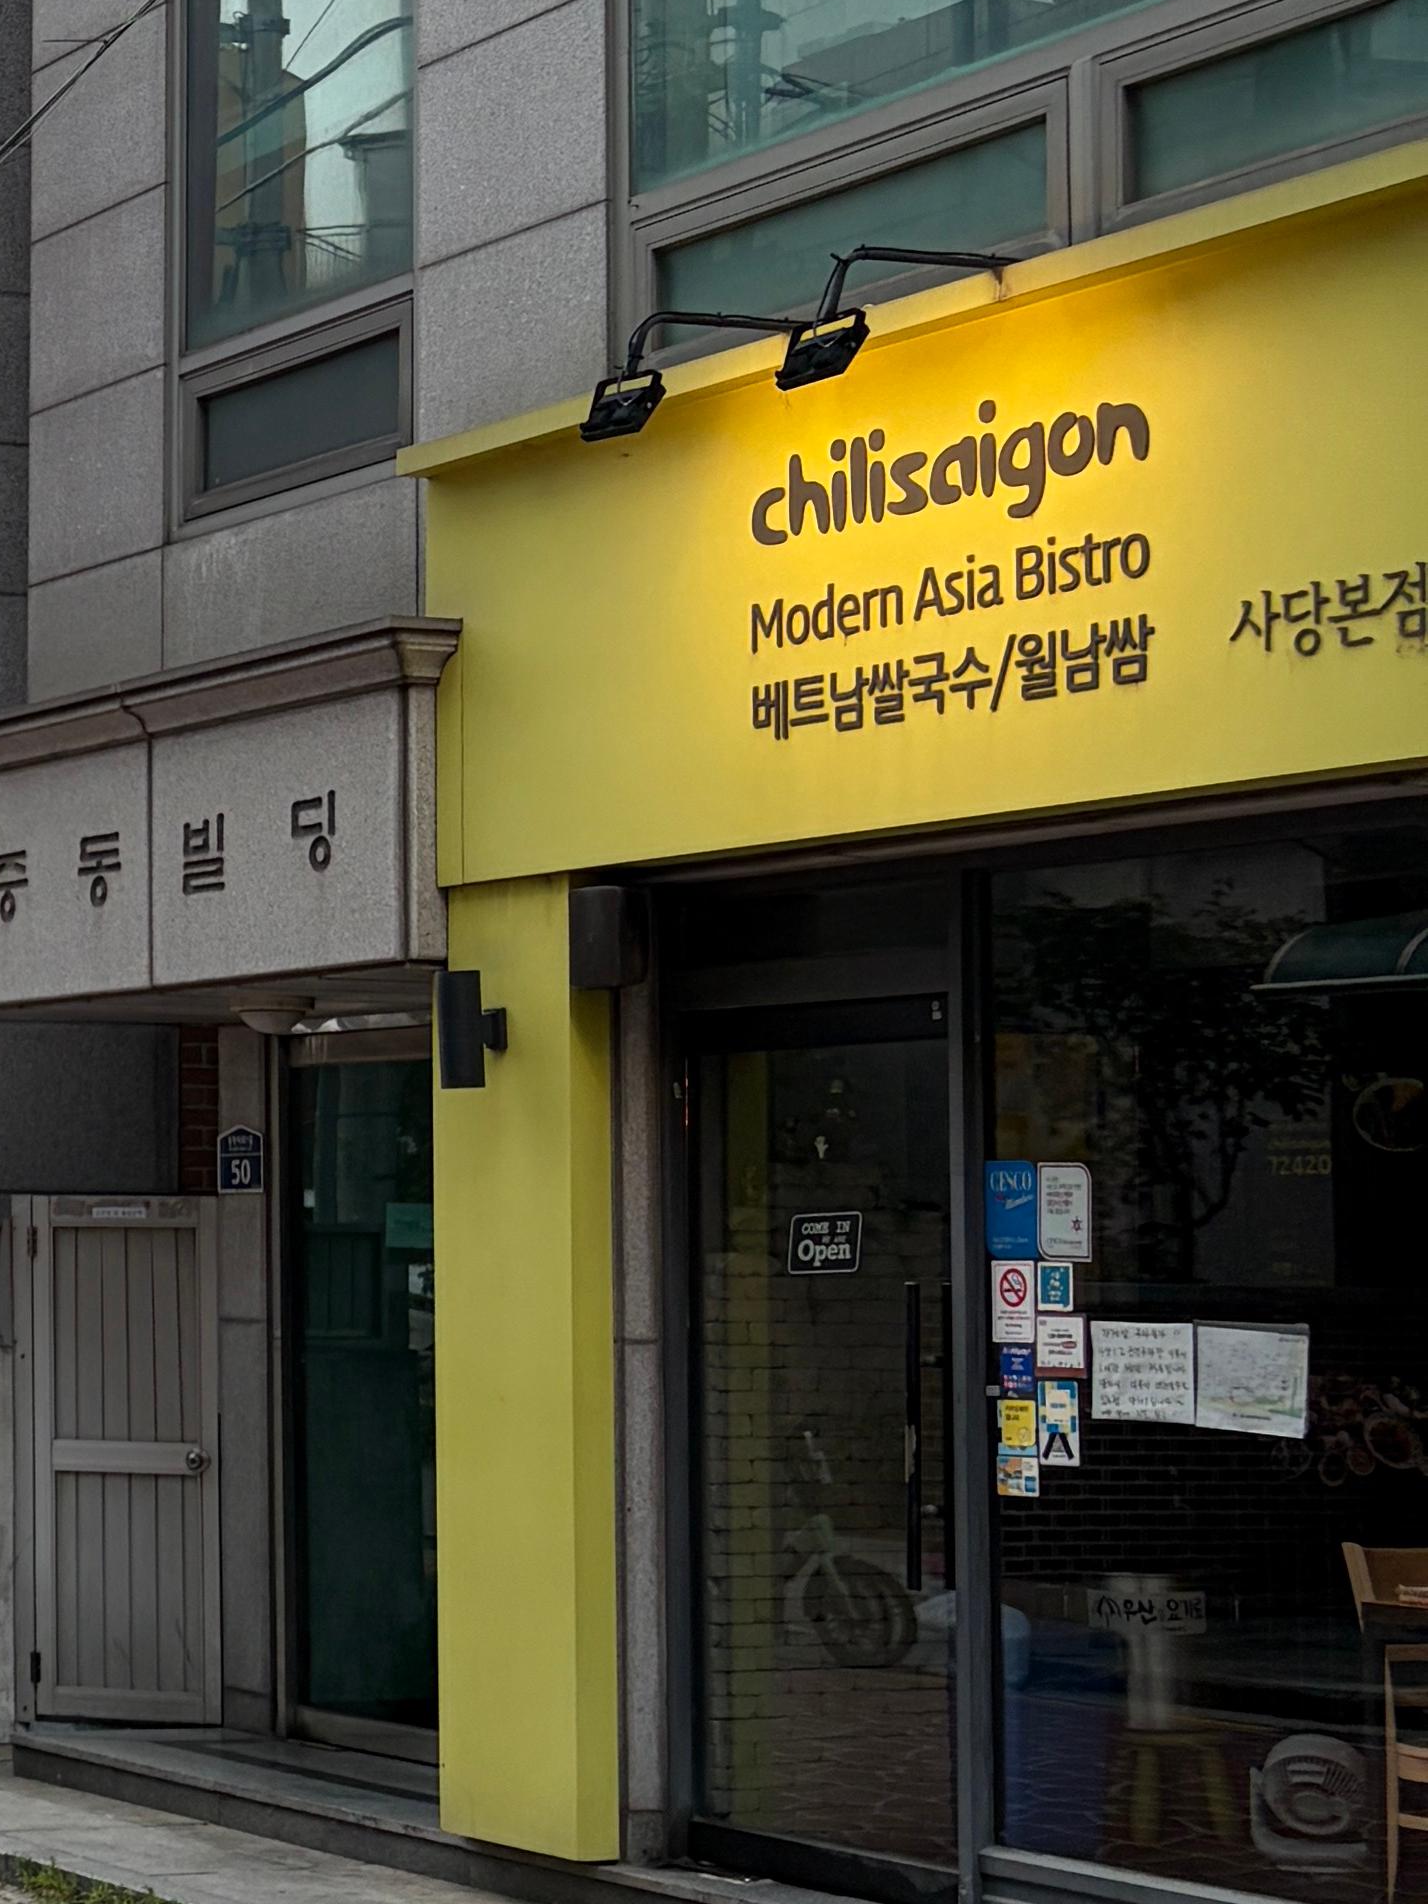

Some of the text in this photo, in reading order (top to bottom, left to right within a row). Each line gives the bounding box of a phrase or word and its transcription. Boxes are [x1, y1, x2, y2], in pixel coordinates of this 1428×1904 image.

[751, 399, 1151, 546] chilisaigon
[751, 531, 1151, 655] Modern Asia Bistro
[1228, 561, 1428, 659] 사당본점
[752, 613, 1156, 742] 베트남쌀국수/월남쌈
[231, 1159, 251, 1185] 50
[990, 1170, 1033, 1194] CESCO
[797, 1239, 852, 1267] Open
[836, 1221, 851, 1233] IN
